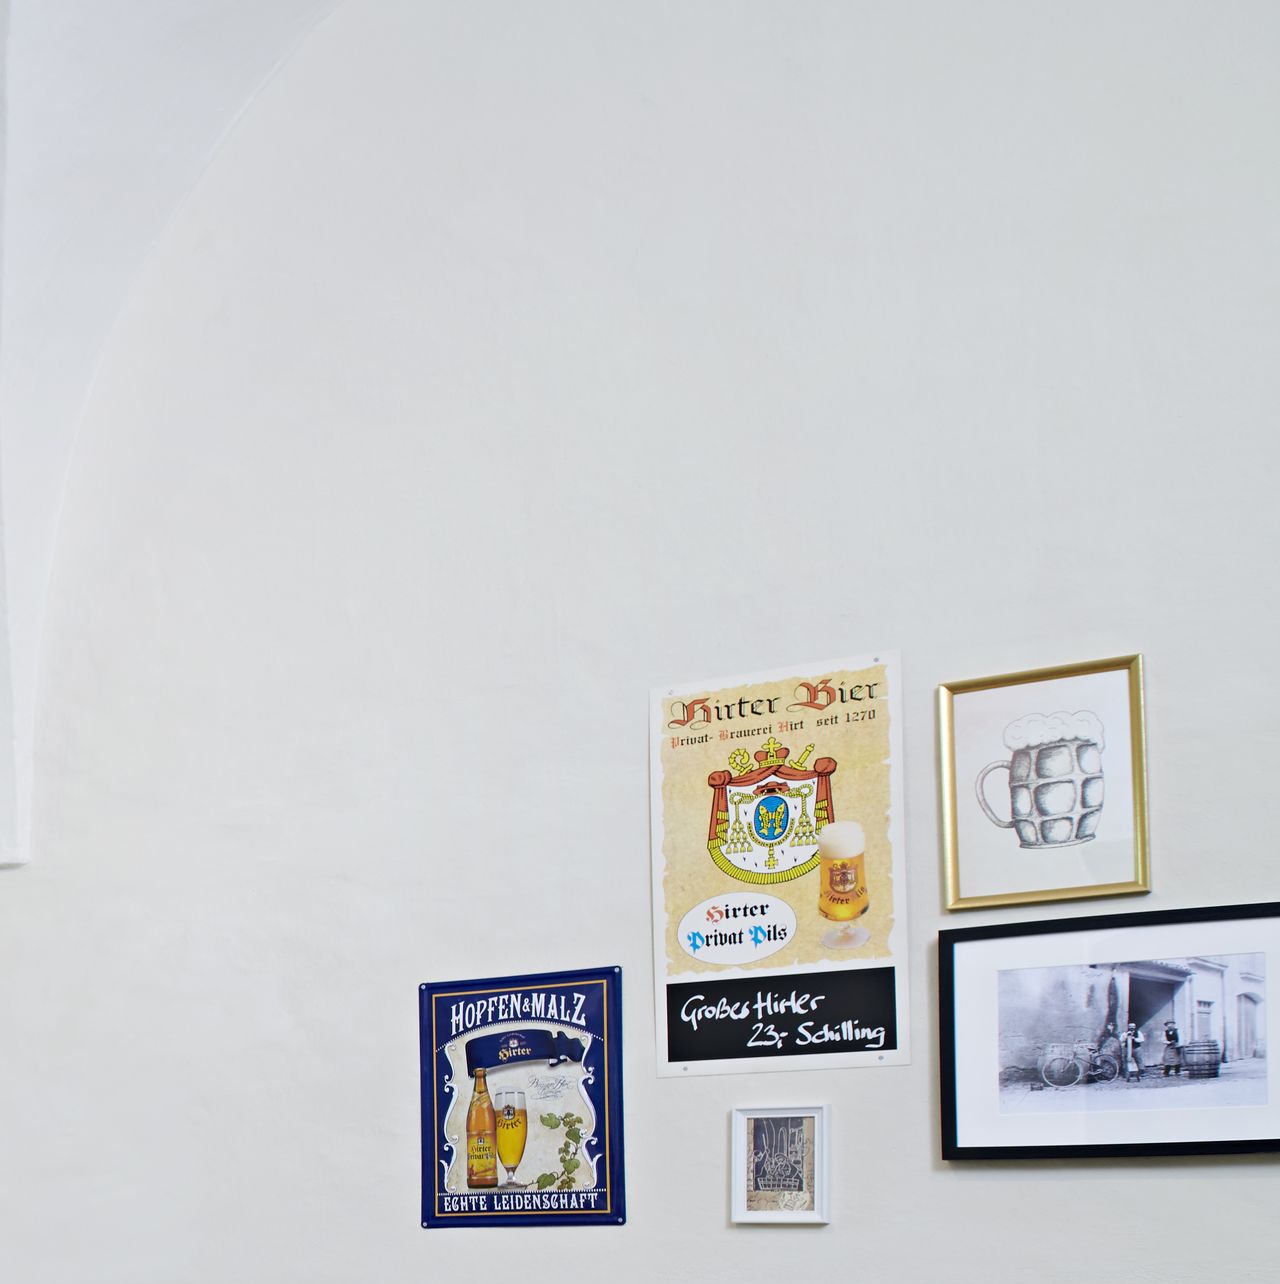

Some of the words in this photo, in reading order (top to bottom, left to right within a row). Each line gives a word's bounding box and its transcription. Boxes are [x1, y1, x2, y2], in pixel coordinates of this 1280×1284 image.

[668, 696, 781, 731] Hirter
[785, 678, 880, 713] Bier
[719, 726, 772, 741] Brauerei
[778, 719, 804, 734] Hirt
[816, 713, 839, 728] seit
[845, 709, 877, 724] 1270
[706, 903, 770, 924] Hirter
[687, 929, 745, 954] Privat
[749, 923, 788, 949] Pils
[680, 994, 750, 1031] Großes
[752, 990, 826, 1020] Hirter
[795, 1019, 886, 1048] Schilling
[498, 1047, 532, 1063] Hirter
[444, 1196, 487, 1212] ECHTE
[494, 1193, 598, 1211] LEIDENSCHAFT
